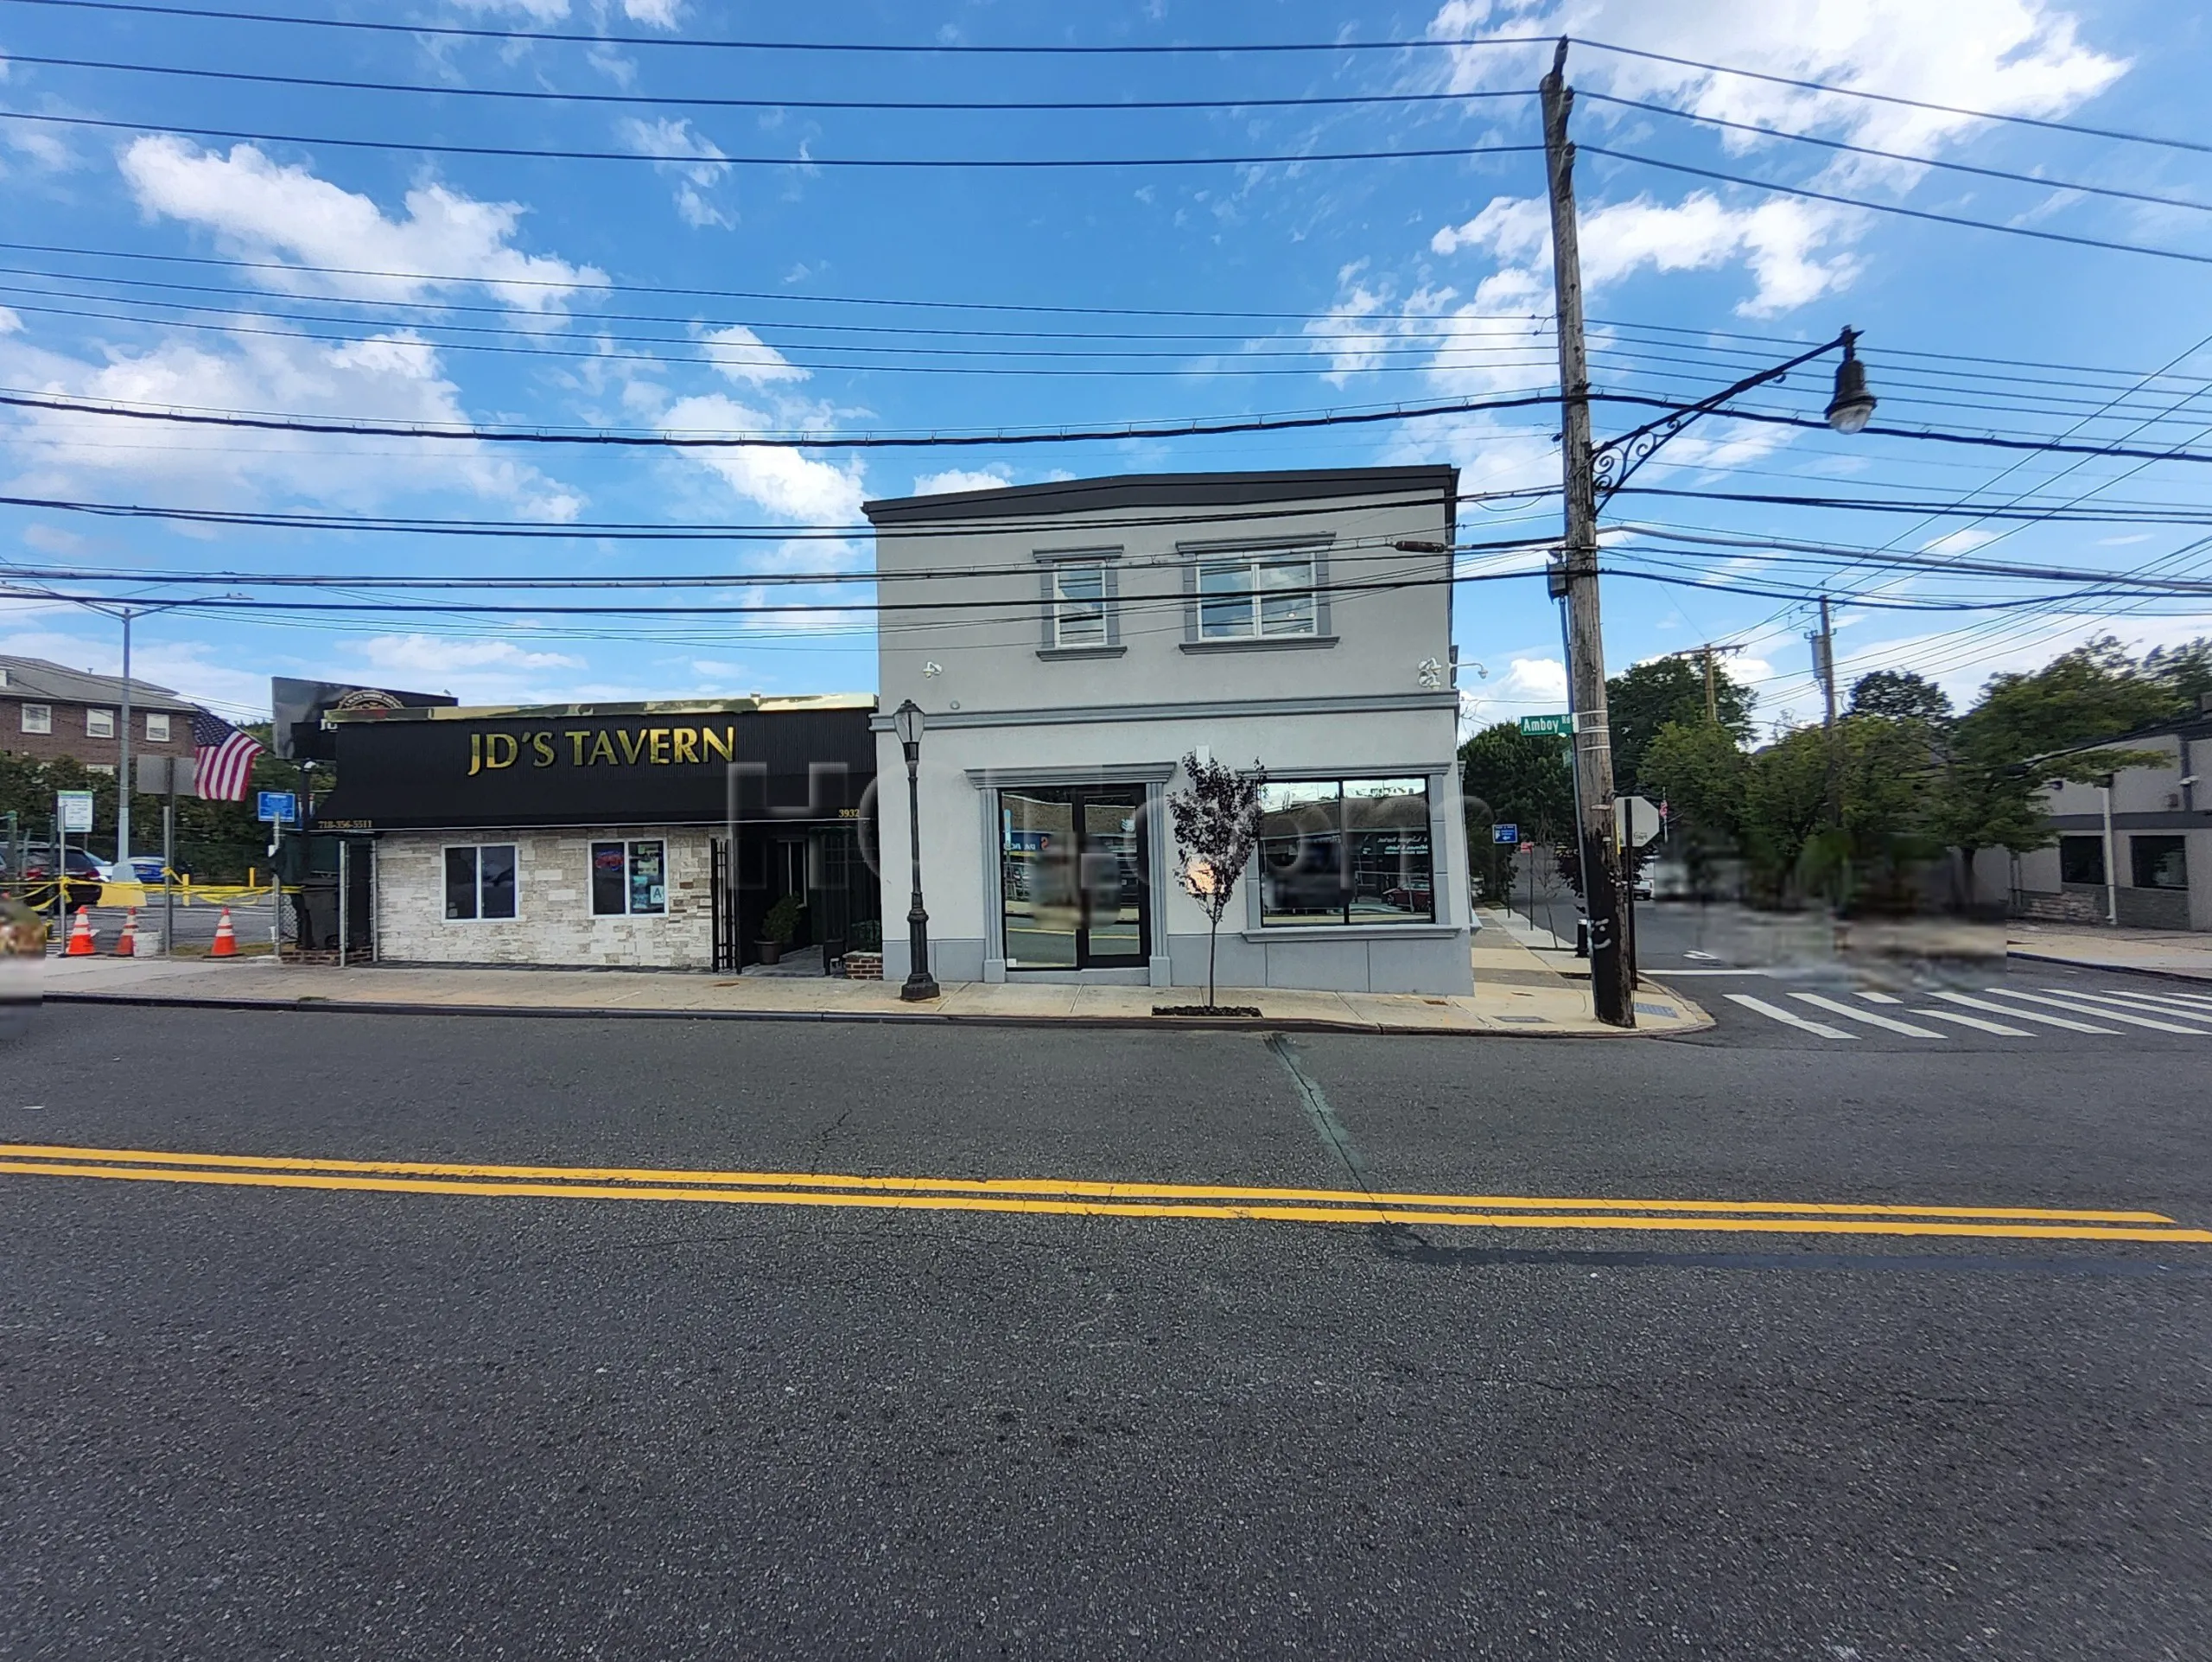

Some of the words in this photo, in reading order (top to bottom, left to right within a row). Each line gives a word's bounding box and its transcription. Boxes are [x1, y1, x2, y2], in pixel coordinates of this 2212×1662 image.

[1523, 717, 1559, 734] Amboy
[1561, 716, 1571, 724] Rd
[467, 731, 554, 776] JD'S
[564, 726, 734, 767] TAVERN
[838, 808, 860, 818] 3932
[317, 819, 372, 829] 718-356-5511
[652, 887, 663, 898] A
